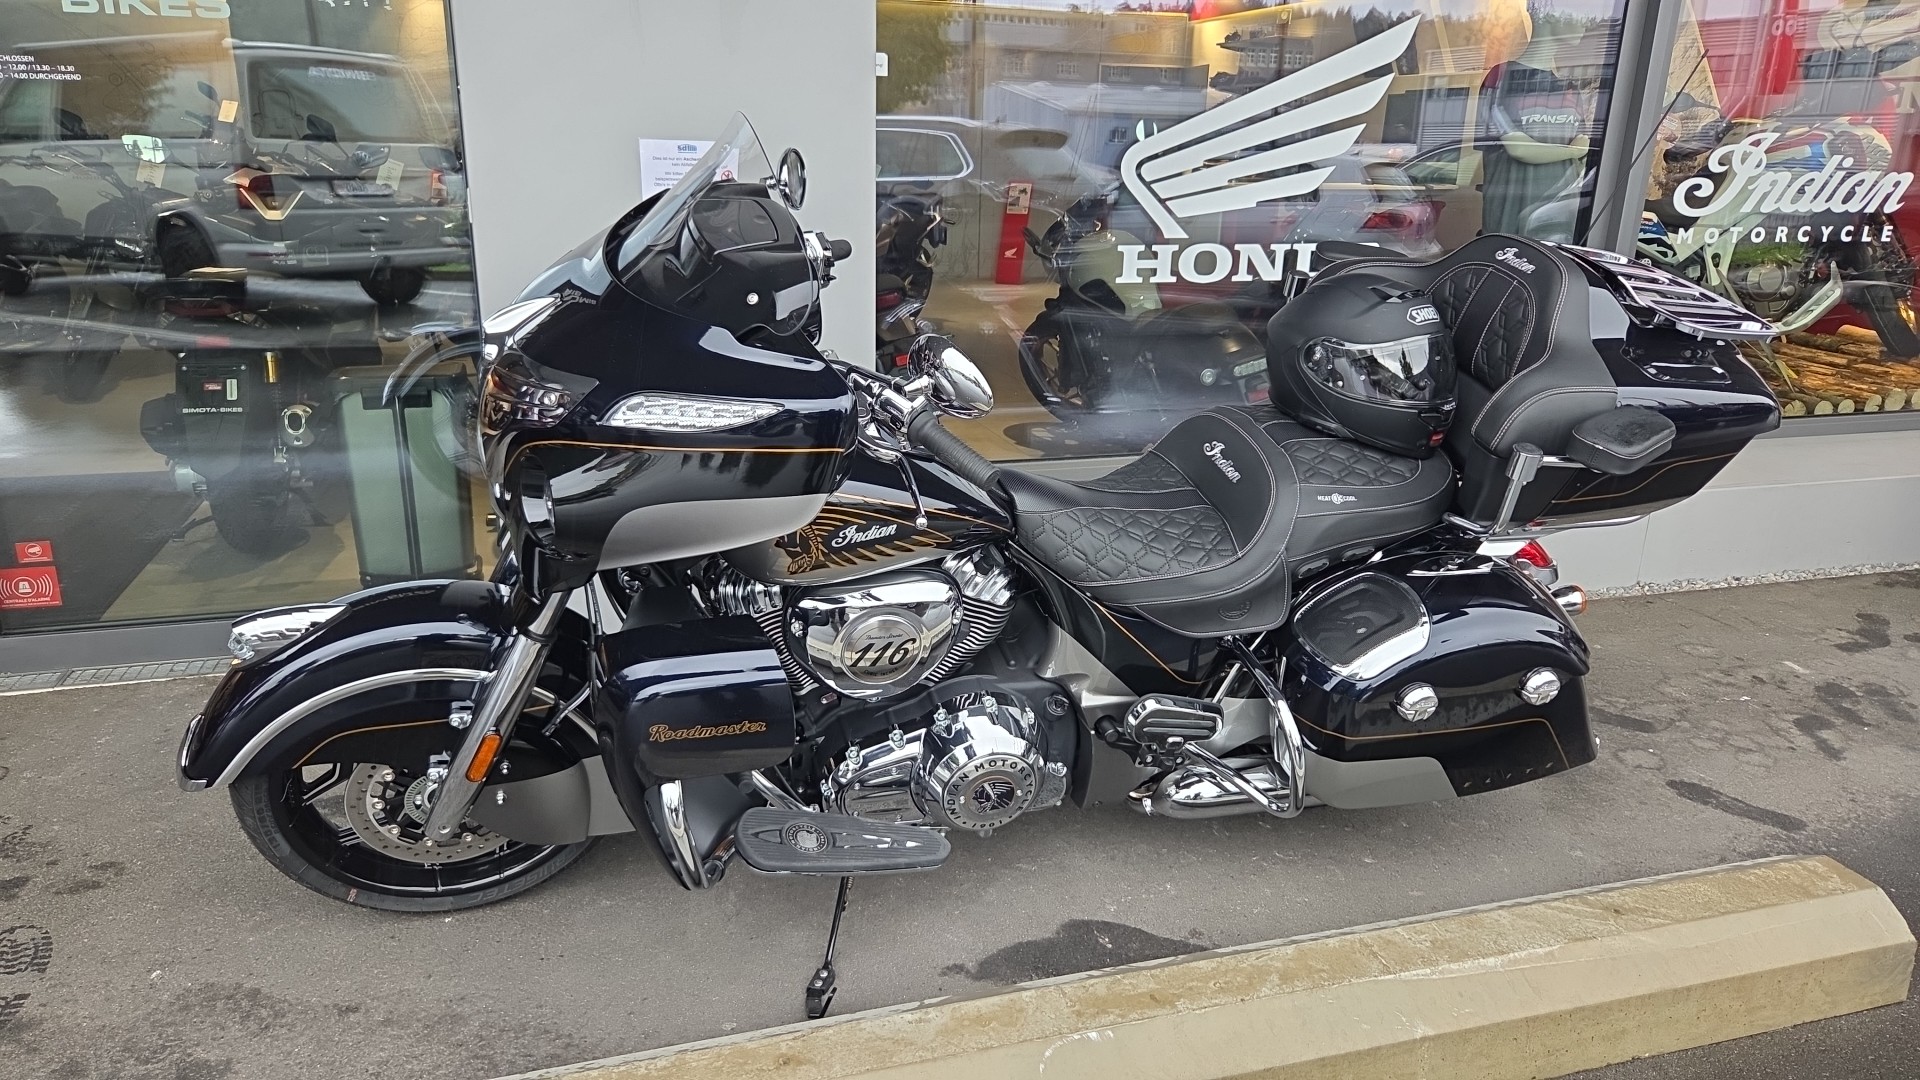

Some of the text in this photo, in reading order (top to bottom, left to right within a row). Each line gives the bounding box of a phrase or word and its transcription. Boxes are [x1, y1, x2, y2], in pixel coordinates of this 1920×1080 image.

[1673, 132, 1915, 217] Indian
[1676, 225, 1894, 245] MOTORCYCLE
[1115, 243, 1380, 284] HON
[1494, 247, 1536, 274] Indian
[1203, 440, 1242, 484] Indian
[831, 523, 898, 548] Indian
[849, 637, 917, 667] 116
[649, 721, 767, 742] Roadmaster
[947, 760, 1034, 820] INDIAN MOTORCYCLE
